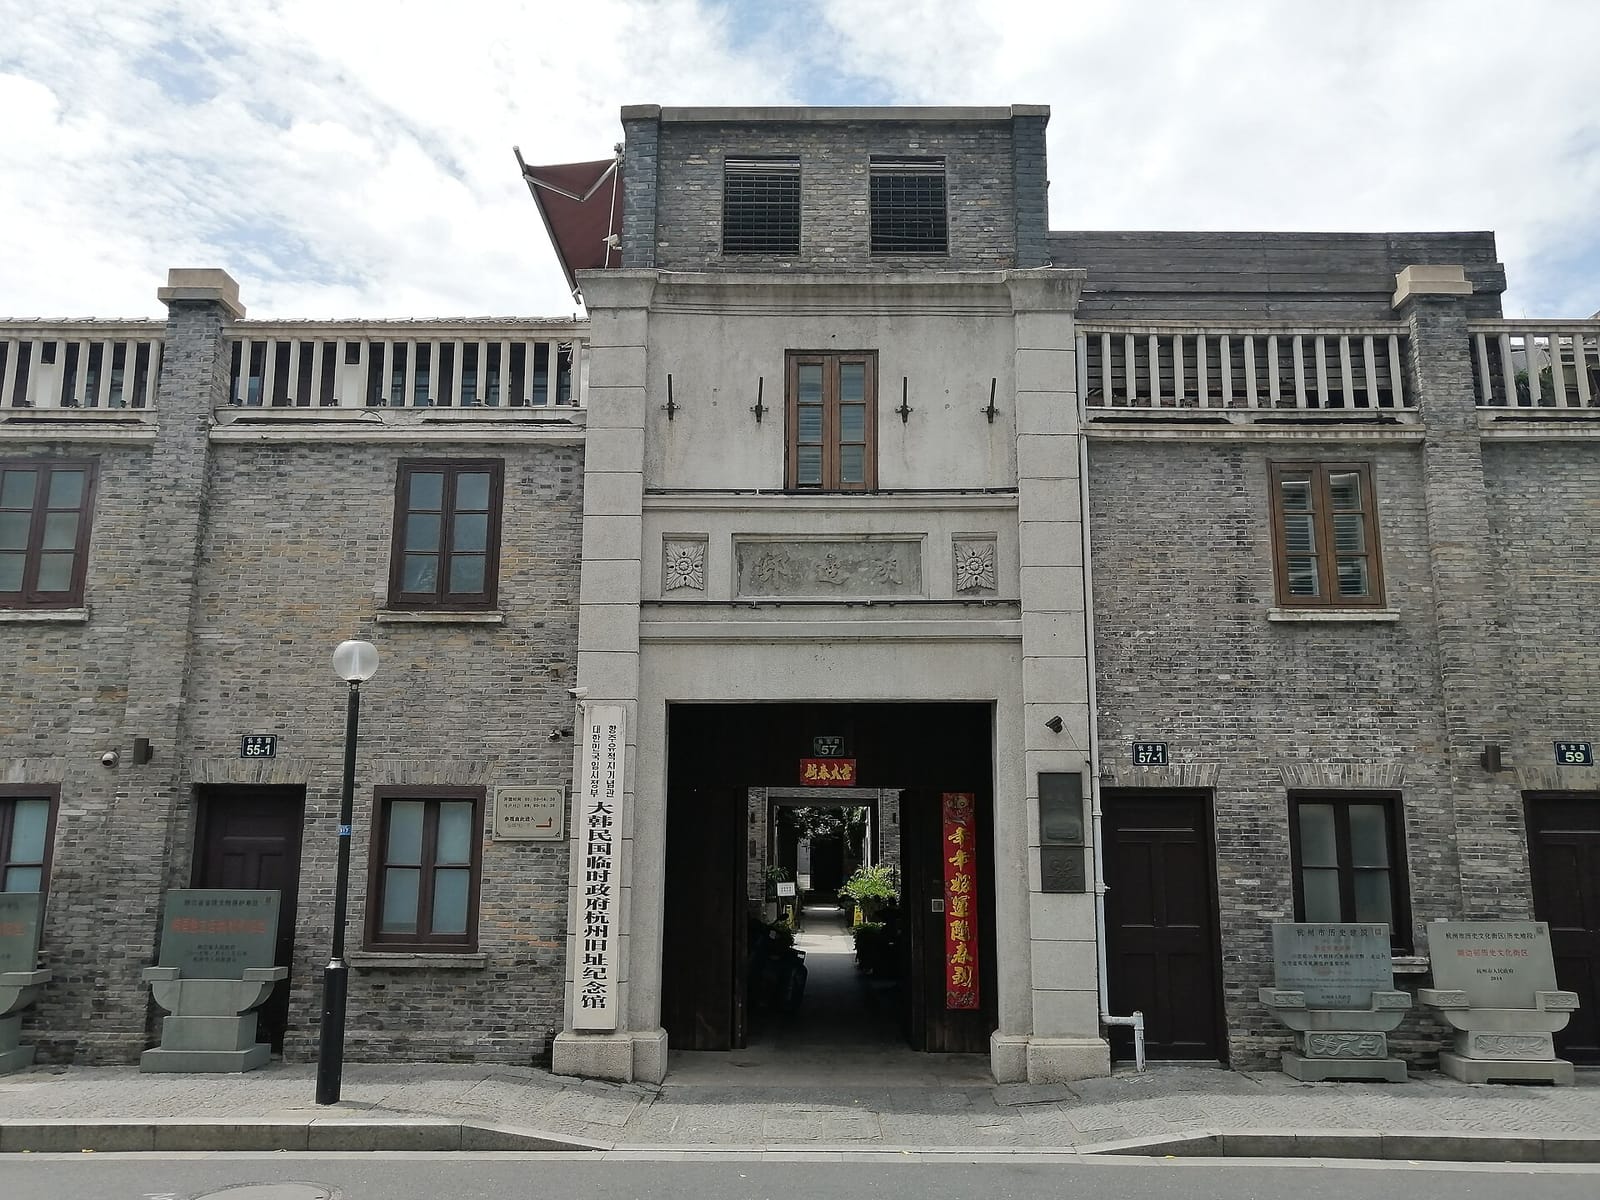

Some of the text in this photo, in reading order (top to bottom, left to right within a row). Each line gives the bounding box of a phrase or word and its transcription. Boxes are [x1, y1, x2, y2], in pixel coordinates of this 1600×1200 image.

[246, 744, 271, 756] 55-1
[821, 745, 838, 755] 57
[590, 724, 601, 798] 대한민국임시정부
[606, 724, 617, 798] 항주유적지기념관
[1138, 752, 1163, 763] 57-1
[1565, 751, 1585, 763] 59
[581, 801, 614, 1009] 大韩民国临时政府杭州旧址纪念馆
